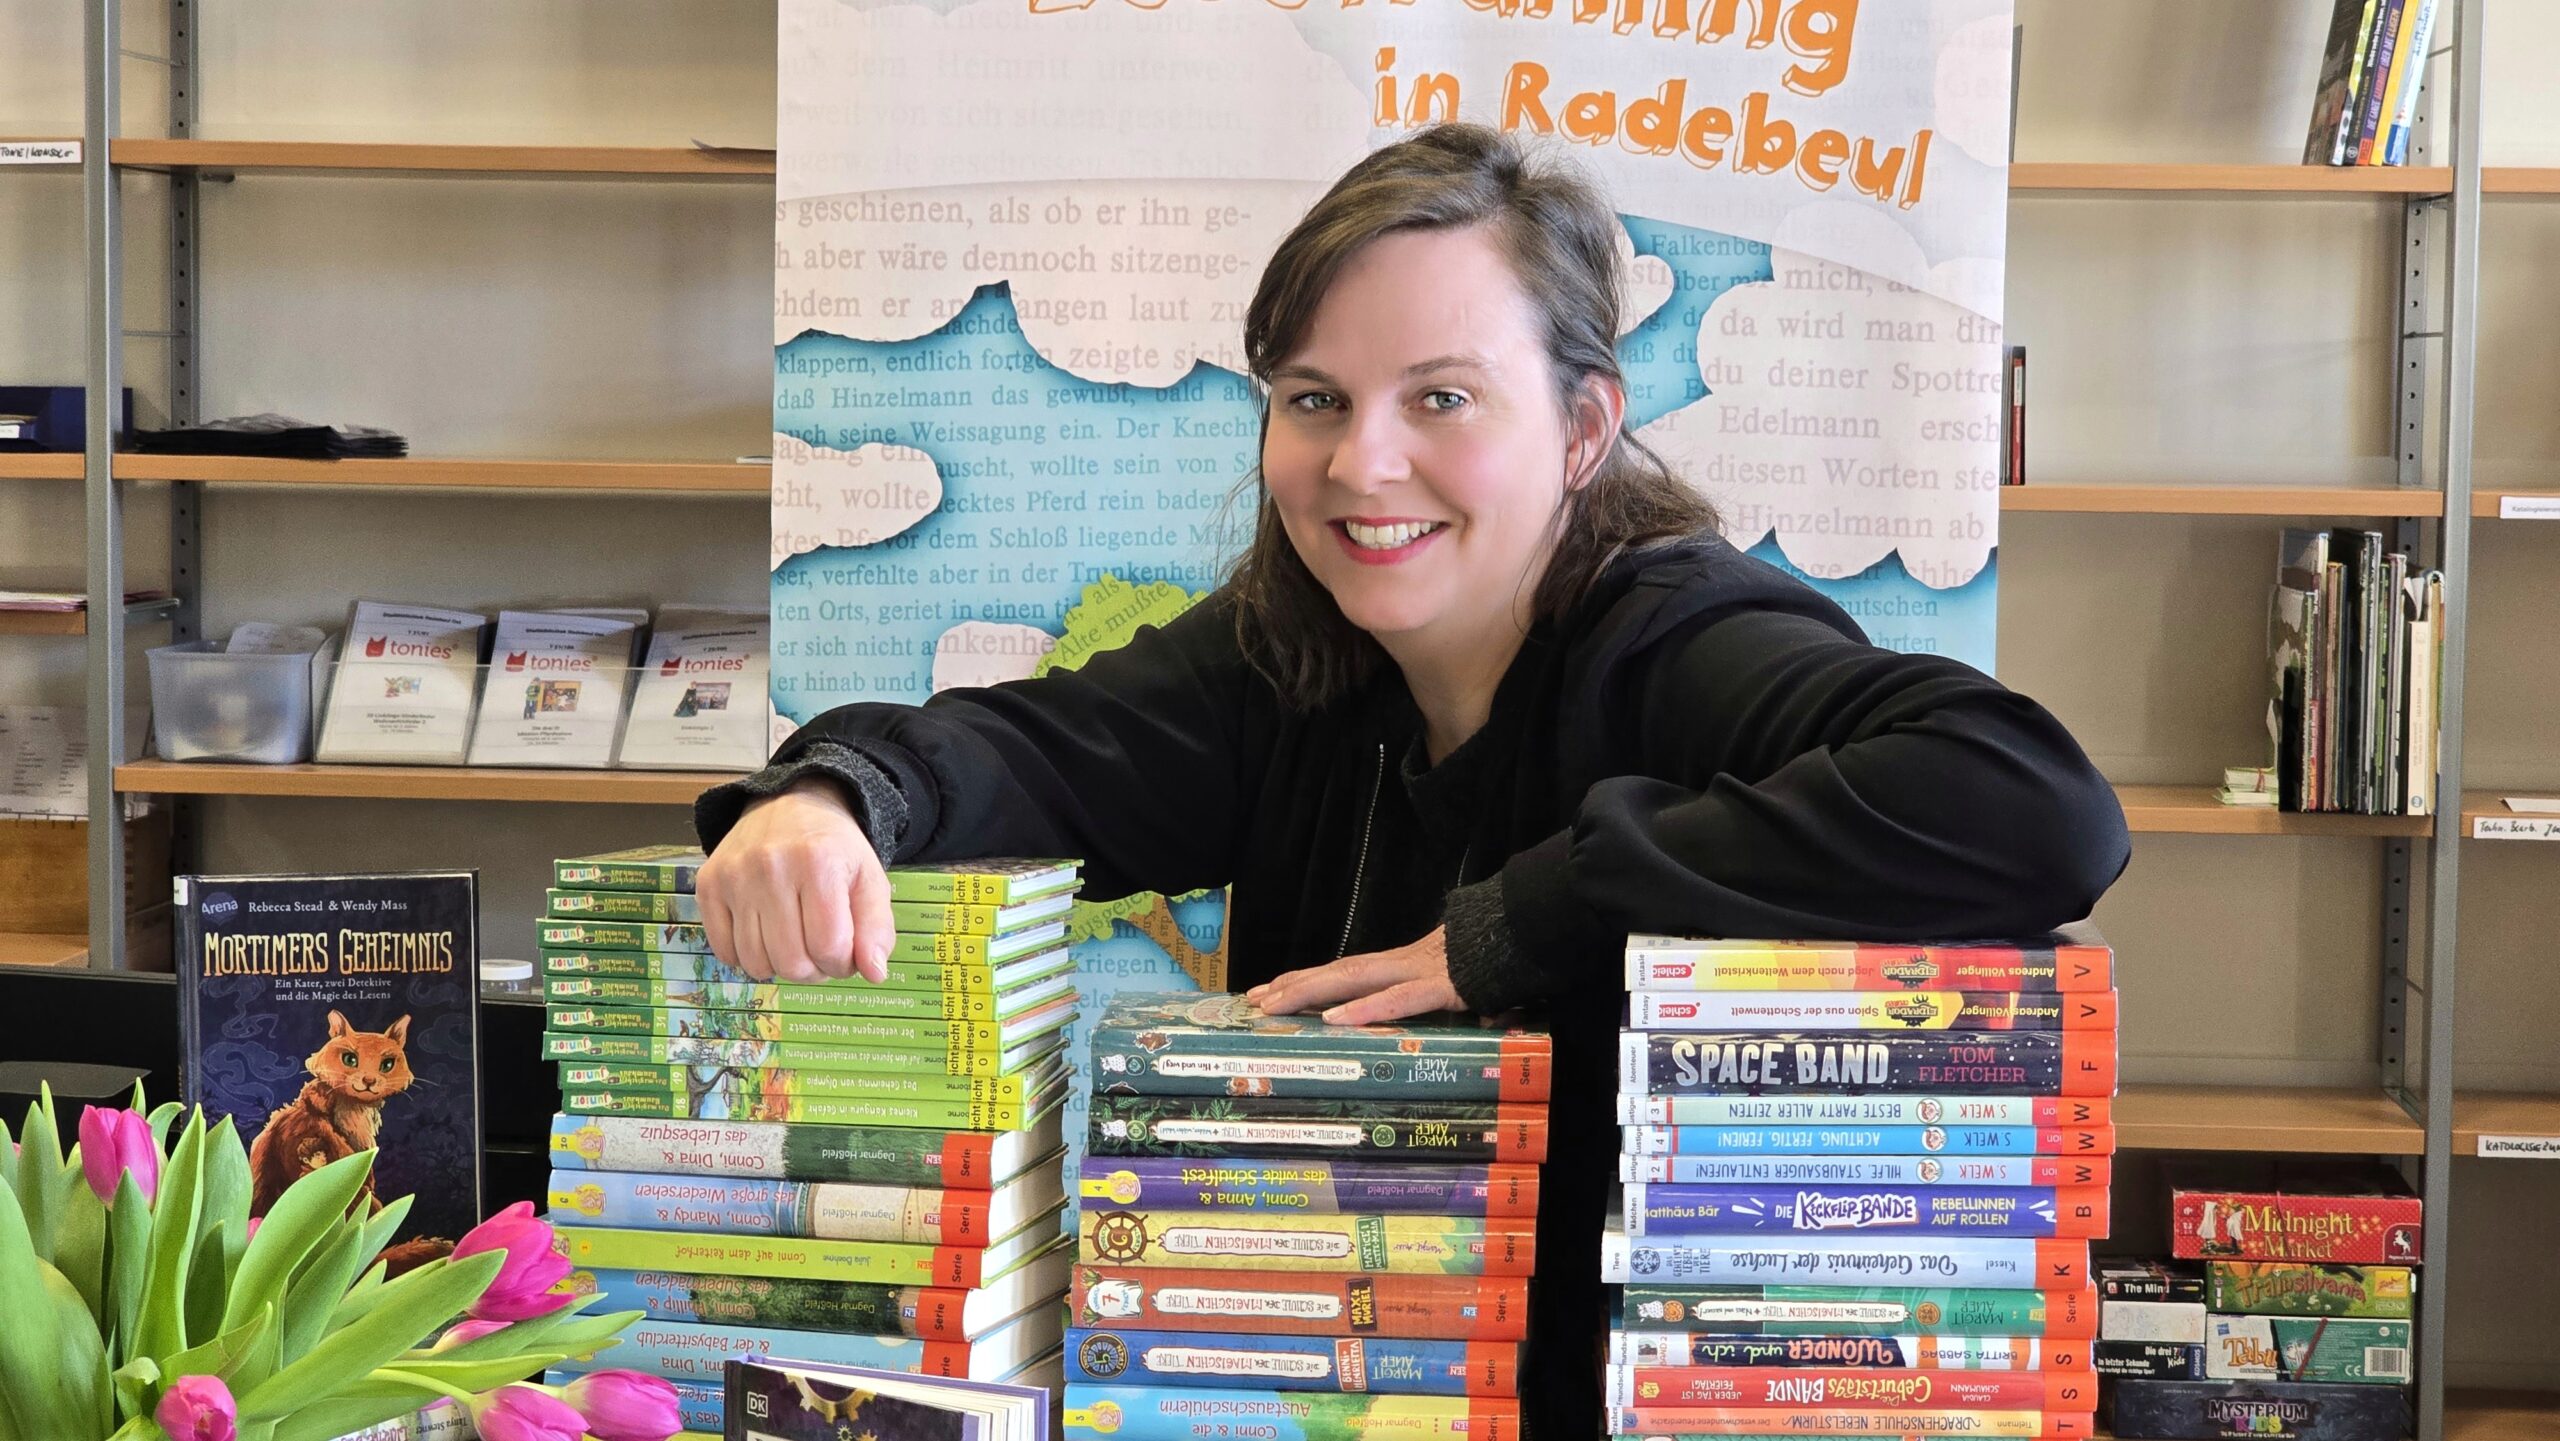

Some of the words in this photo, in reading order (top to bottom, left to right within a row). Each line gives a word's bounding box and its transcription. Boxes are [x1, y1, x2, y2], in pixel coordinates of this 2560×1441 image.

[1374, 46, 1461, 128] in
[1502, 61, 1934, 210] Radebeul
[798, 198, 974, 228] geschienen,
[988, 196, 1030, 224] als
[1045, 193, 1081, 224] ob
[1097, 206, 1125, 224] er
[1140, 194, 1191, 226] ihn
[1205, 205, 1251, 234] ge-
[804, 243, 863, 270] aber
[879, 243, 947, 271] wäre
[962, 243, 1096, 274] dennoch
[1111, 245, 1251, 280] sitzenge-
[1783, 262, 1873, 297] mich,
[881, 298, 911, 318] er
[1130, 292, 1191, 322] laut
[1211, 302, 1244, 324] zu
[1720, 310, 1757, 337] da
[1778, 312, 1845, 339] wird
[1865, 320, 1935, 343] man
[778, 352, 876, 378] klappern,
[886, 349, 971, 373] endlich
[1069, 343, 1159, 378] zeigte
[1705, 357, 1743, 385] du
[1767, 360, 1869, 390] deiner
[777, 391, 815, 411] daß
[832, 387, 972, 408] Hinzelmann
[991, 386, 1028, 407] das
[839, 424, 896, 445] seine
[911, 420, 1046, 447] Weissagung
[1116, 418, 1158, 440] Der
[1173, 416, 1257, 440] Knecht
[1719, 405, 1880, 440] Edelmann
[1031, 455, 1099, 477] wollte
[1113, 455, 1160, 476] sein
[1177, 459, 1218, 475] von
[1707, 454, 1807, 485] diesen
[1822, 459, 1940, 491] Worten
[841, 484, 930, 511] wollte
[1027, 490, 1087, 514] Pferd
[1099, 491, 1145, 511] rein
[1157, 489, 1223, 511] baden
[1737, 503, 1934, 539] Hinzelmann
[1949, 512, 1985, 541] ab
[928, 529, 978, 551] dem
[990, 526, 1068, 549] Schloß
[1079, 525, 1178, 552] liegende
[823, 563, 919, 586] verfehlte
[928, 564, 980, 586] aber
[988, 563, 1010, 584] in
[1022, 563, 1060, 584] der
[819, 601, 870, 625] Orts,
[878, 600, 942, 625] geriet
[952, 600, 973, 620] in
[982, 600, 1047, 621] einen
[1104, 583, 1171, 633] mußte
[391, 641, 452, 660] tonies
[804, 637, 848, 658] sich
[856, 636, 913, 658] nicht
[531, 652, 592, 672] tonies
[684, 656, 743, 673] tonies
[804, 672, 865, 694] hinab
[874, 671, 916, 693] und
[201, 899, 239, 914] Arena
[249, 901, 291, 912] Rebecca
[294, 901, 323, 912] Stead
[341, 901, 378, 912] Wendy
[381, 900, 408, 911] Mass
[203, 932, 330, 977] MORTIMERS
[339, 928, 453, 975] GEHEIMNIS
[1713, 966, 1789, 978] Weltenkristall
[1956, 964, 2006, 978] Völlinger
[2007, 966, 2055, 978] Andreas
[275, 979, 292, 989] Ein
[294, 978, 323, 989] Kater,
[325, 979, 345, 988] zwei
[347, 978, 392, 988] Detektive
[275, 991, 292, 1001] und
[295, 991, 309, 1001] die
[312, 991, 340, 1003] Magie
[342, 991, 357, 1000] des
[359, 991, 391, 1000] Lesens
[1730, 1006, 1802, 1019] Schattenwelt
[1847, 1005, 1880, 1019] Spion
[852, 1023, 898, 1038] verborgene
[1629, 1045, 1638, 1084] Abenteuer
[1671, 1040, 1786, 1087] SPACE
[1794, 1042, 1890, 1085] BAND
[1949, 1046, 1996, 1065] TOM
[1405, 1068, 1458, 1083] MARGIT
[1917, 1065, 2027, 1083] FLETCHER
[1728, 1103, 1773, 1118] ZEITEN
[1777, 1103, 1814, 1118] ALLER
[1819, 1103, 1857, 1118] PARTY
[1863, 1103, 1902, 1118] BESTE
[640, 1126, 721, 1145] Liebesquiz
[724, 1130, 748, 1144] das
[1717, 1131, 1763, 1147] FERIEN!
[679, 1153, 714, 1168] Dina
[720, 1152, 765, 1170] Conni,
[822, 1148, 858, 1160] Hoßfeld
[860, 1149, 896, 1163] Dagmar
[1182, 1167, 1258, 1187] Schulfest
[1262, 1169, 1299, 1186] wilde
[1303, 1169, 1327, 1183] das
[1695, 1163, 1769, 1179] ENTLAUFEN!
[1774, 1163, 1862, 1179] STAUBSAUGER
[2074, 1164, 2093, 1183] W
[634, 1184, 726, 1203] Wiedersehen
[731, 1187, 769, 1205] große
[773, 1189, 796, 1204] das
[1217, 1192, 1256, 1207] Anna
[1262, 1191, 1309, 1208] Conni,
[1931, 1197, 2016, 1212] REBELLINNEN
[673, 1207, 721, 1228] Mandy
[726, 1211, 772, 1229] Conni,
[1931, 1212, 1955, 1226] AUF
[1958, 1212, 2010, 1226] ROLLEN
[2243, 1204, 2355, 1241] Midnight
[1205, 1235, 1272, 1251] MAGISCHEN
[675, 1245, 725, 1260] Reiterhof
[777, 1251, 807, 1264] Conni
[1730, 1251, 1788, 1274] Luchse
[1826, 1253, 1914, 1277] Geheimnis
[1985, 1259, 2017, 1273] Kiesel
[634, 1272, 742, 1294] Supermädchen
[2123, 1283, 2144, 1294] The
[635, 1331, 729, 1353] Babysitterclub
[732, 1339, 755, 1353] der
[1701, 1344, 1737, 1363] ich
[1787, 1339, 1895, 1366] WONDER
[1920, 1349, 1973, 1360] SABBAG
[2222, 1337, 2279, 1367] Tabu
[1371, 1365, 1423, 1381] MARGIT
[1764, 1376, 1826, 1404] BANDE
[1950, 1383, 2001, 1394] SCHAUMANN
[748, 1398, 768, 1414] DK
[1159, 1400, 1312, 1419] Austauschschülerin
[2207, 1400, 2309, 1420] MYSTERIUM
[1192, 1423, 1212, 1439] die
[1791, 1415, 1869, 1430] NEBELSTURM
[1873, 1415, 1972, 1430] DRACHENSCHULE
[2235, 1413, 2283, 1433] KIDS
[1234, 1424, 1278, 1441] Conni
